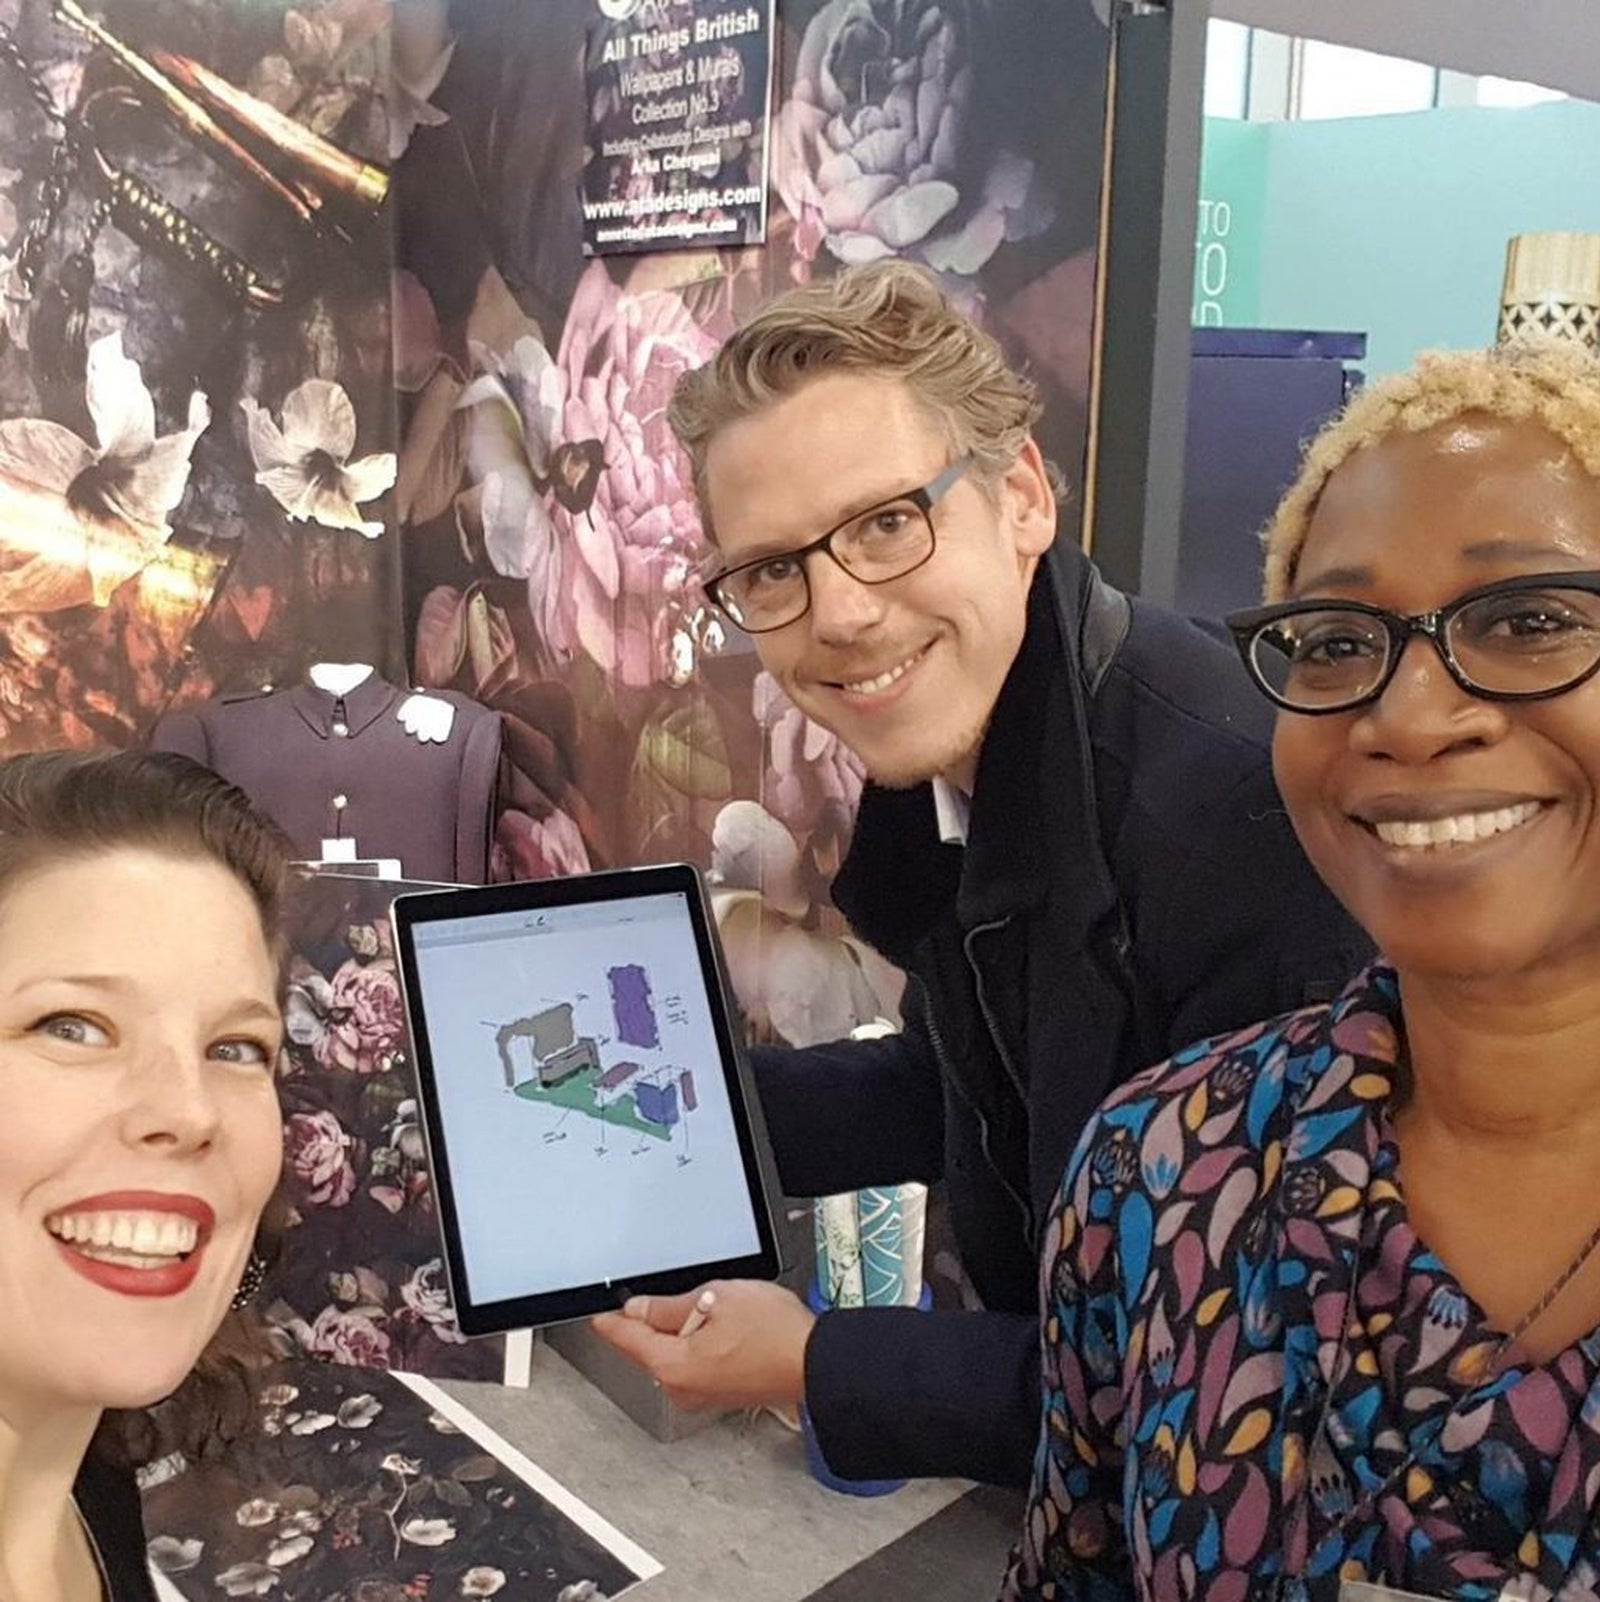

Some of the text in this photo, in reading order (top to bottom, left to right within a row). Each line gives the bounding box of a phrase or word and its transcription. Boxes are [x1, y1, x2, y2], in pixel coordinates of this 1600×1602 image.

[602, 38, 626, 63] All
[629, 26, 690, 57] Things
[695, 9, 760, 43] British
[620, 66, 684, 98] Wallpapers
[685, 58, 696, 85] &
[632, 97, 688, 125] Collection
[1198, 199, 1231, 236] TO
